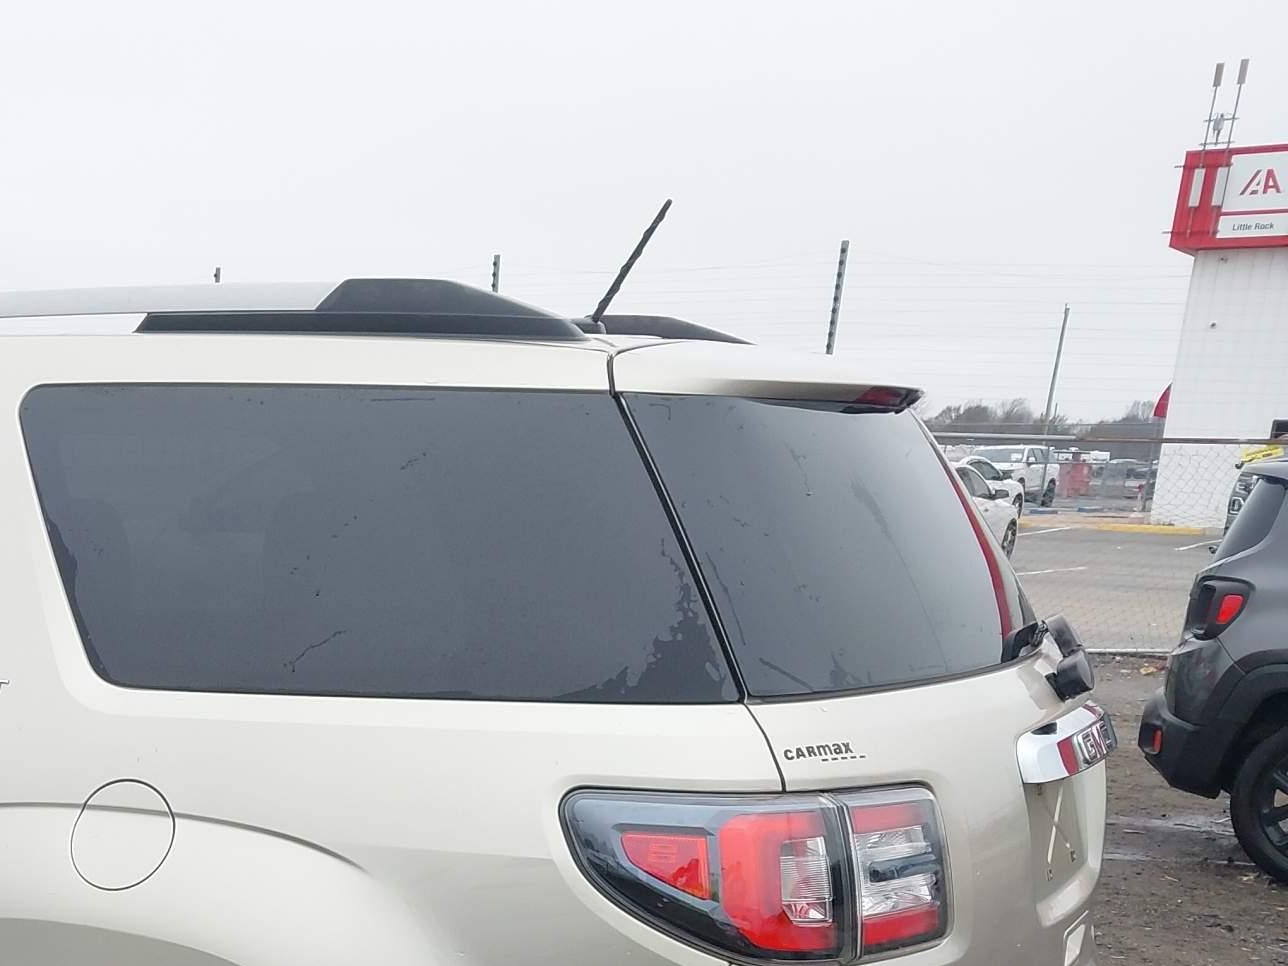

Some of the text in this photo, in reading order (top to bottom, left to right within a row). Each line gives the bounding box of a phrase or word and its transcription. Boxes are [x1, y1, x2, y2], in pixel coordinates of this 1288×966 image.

[1232, 221, 1274, 232] Little Rock
[1076, 720, 1113, 762] GMC
